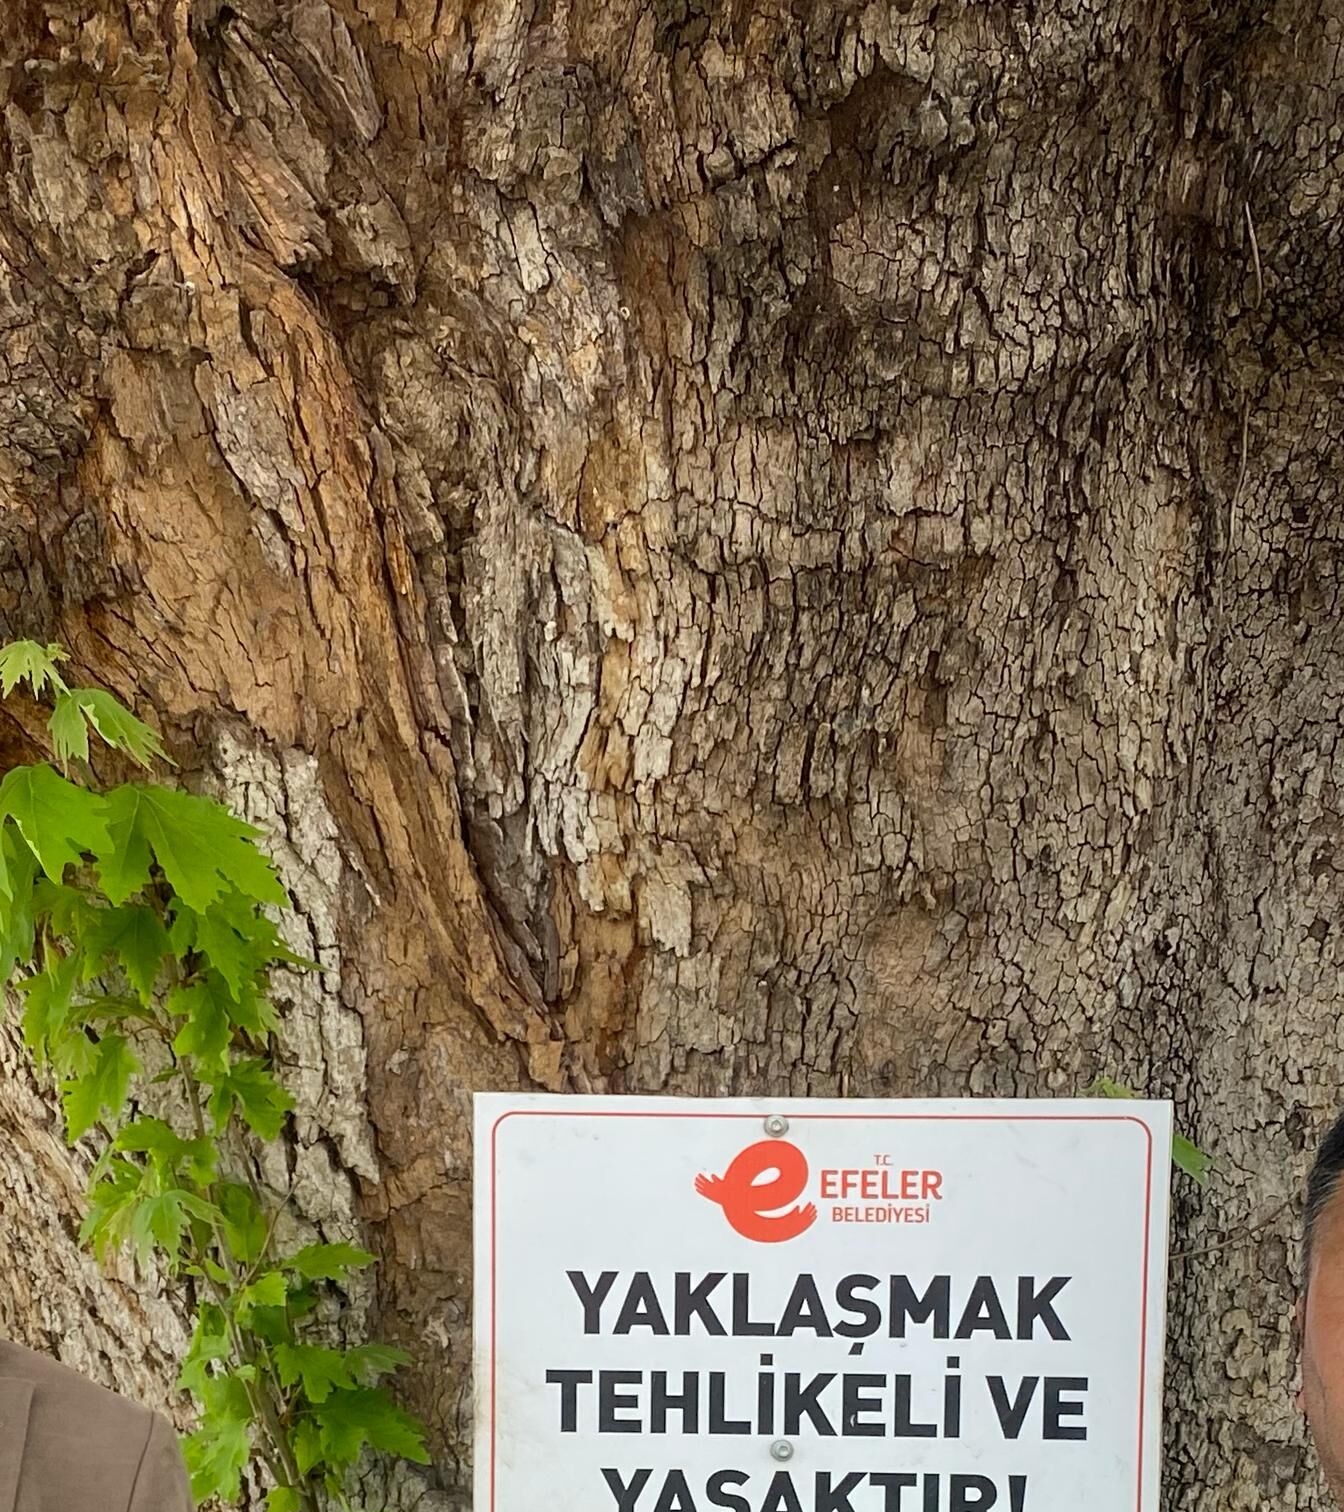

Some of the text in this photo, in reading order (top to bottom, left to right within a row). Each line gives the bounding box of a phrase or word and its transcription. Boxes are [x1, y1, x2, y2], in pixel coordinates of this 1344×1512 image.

[873, 1154, 894, 1166] T.C.
[820, 1169, 943, 1200] EFELER
[831, 1203, 930, 1223] BELEDİYESİ
[565, 1270, 1073, 1356] YAKLAŞMAK
[545, 1353, 1089, 1441] TEHLİKELİ VE
